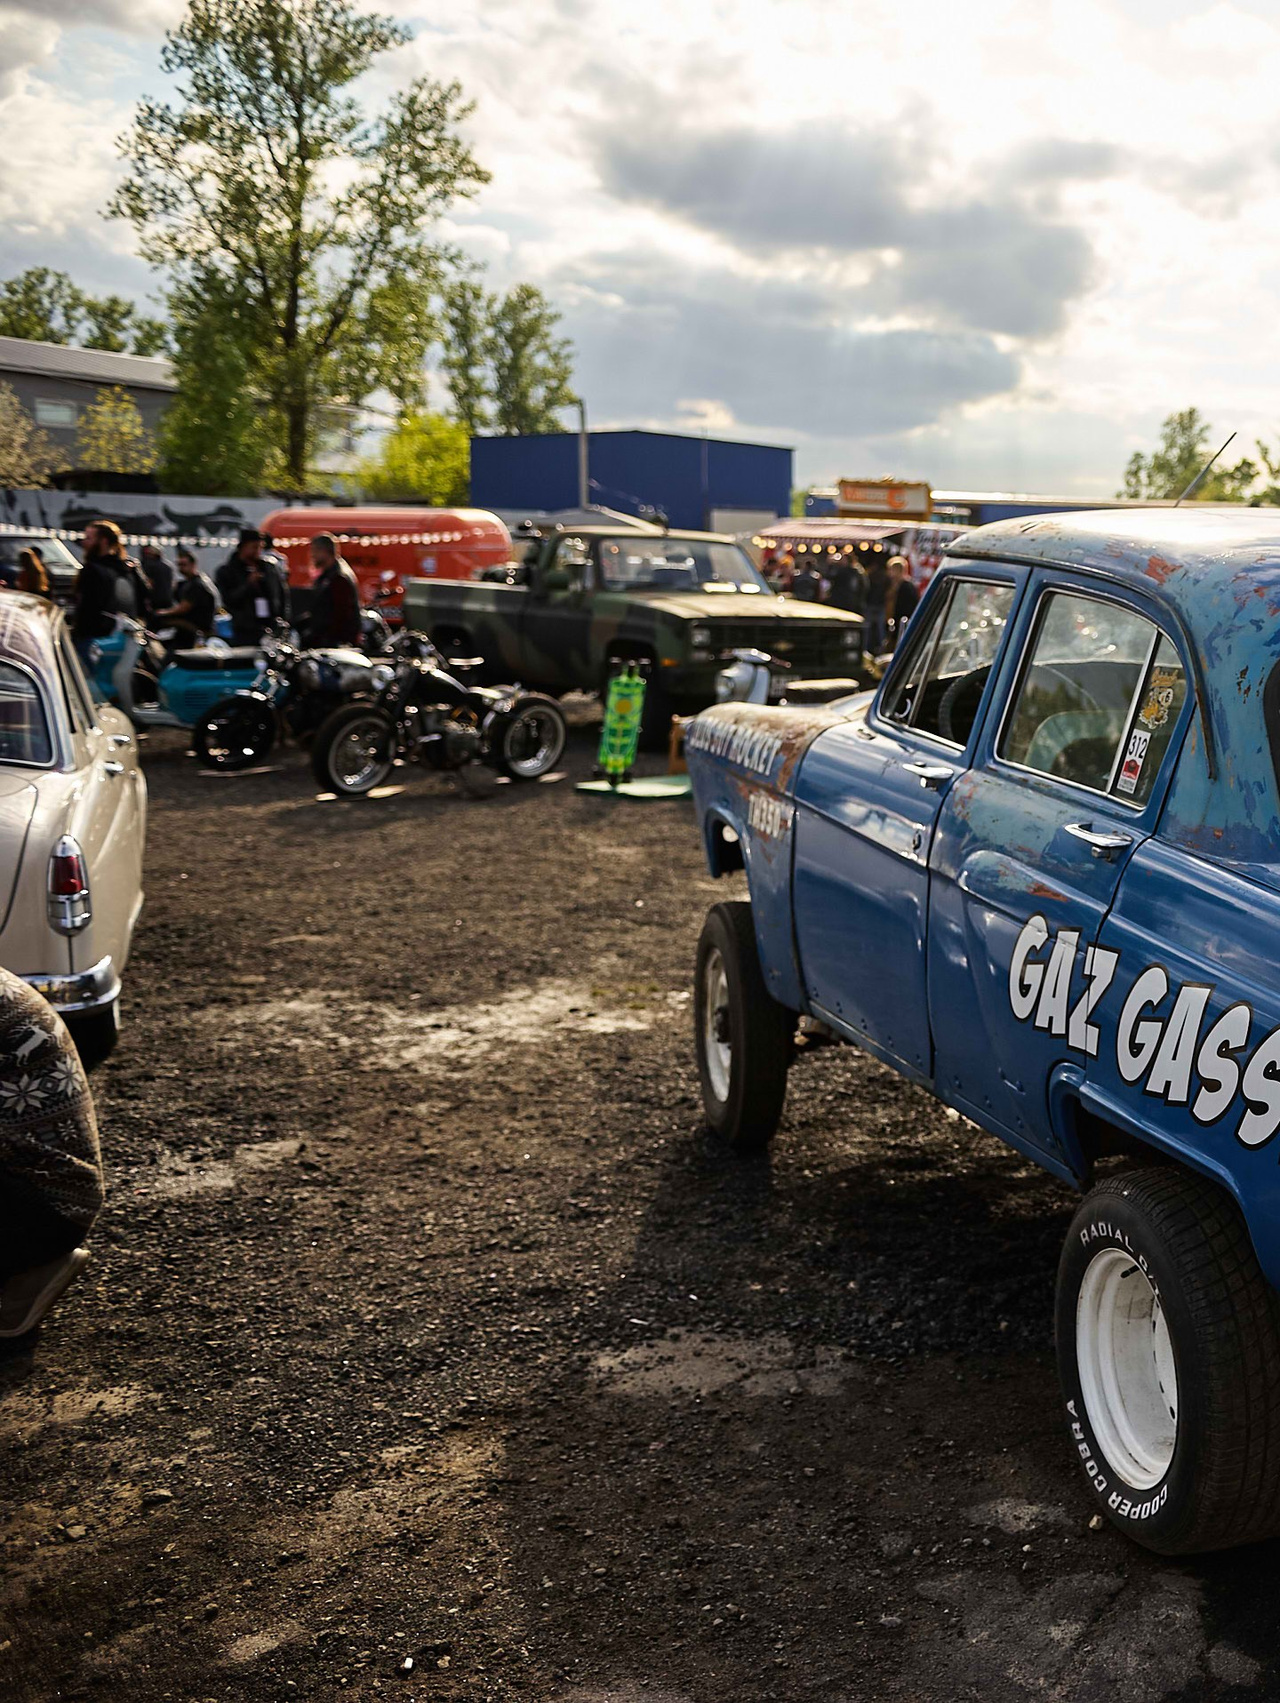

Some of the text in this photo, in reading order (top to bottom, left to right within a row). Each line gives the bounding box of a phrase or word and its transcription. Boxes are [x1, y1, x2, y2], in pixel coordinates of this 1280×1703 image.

[728, 725, 783, 776] ROCKET
[1129, 735, 1148, 759] 312
[1009, 913, 1121, 1055] GAZ
[1080, 1222, 1134, 1253] RADIAL
[1066, 1400, 1168, 1520] COOPER COBRA
